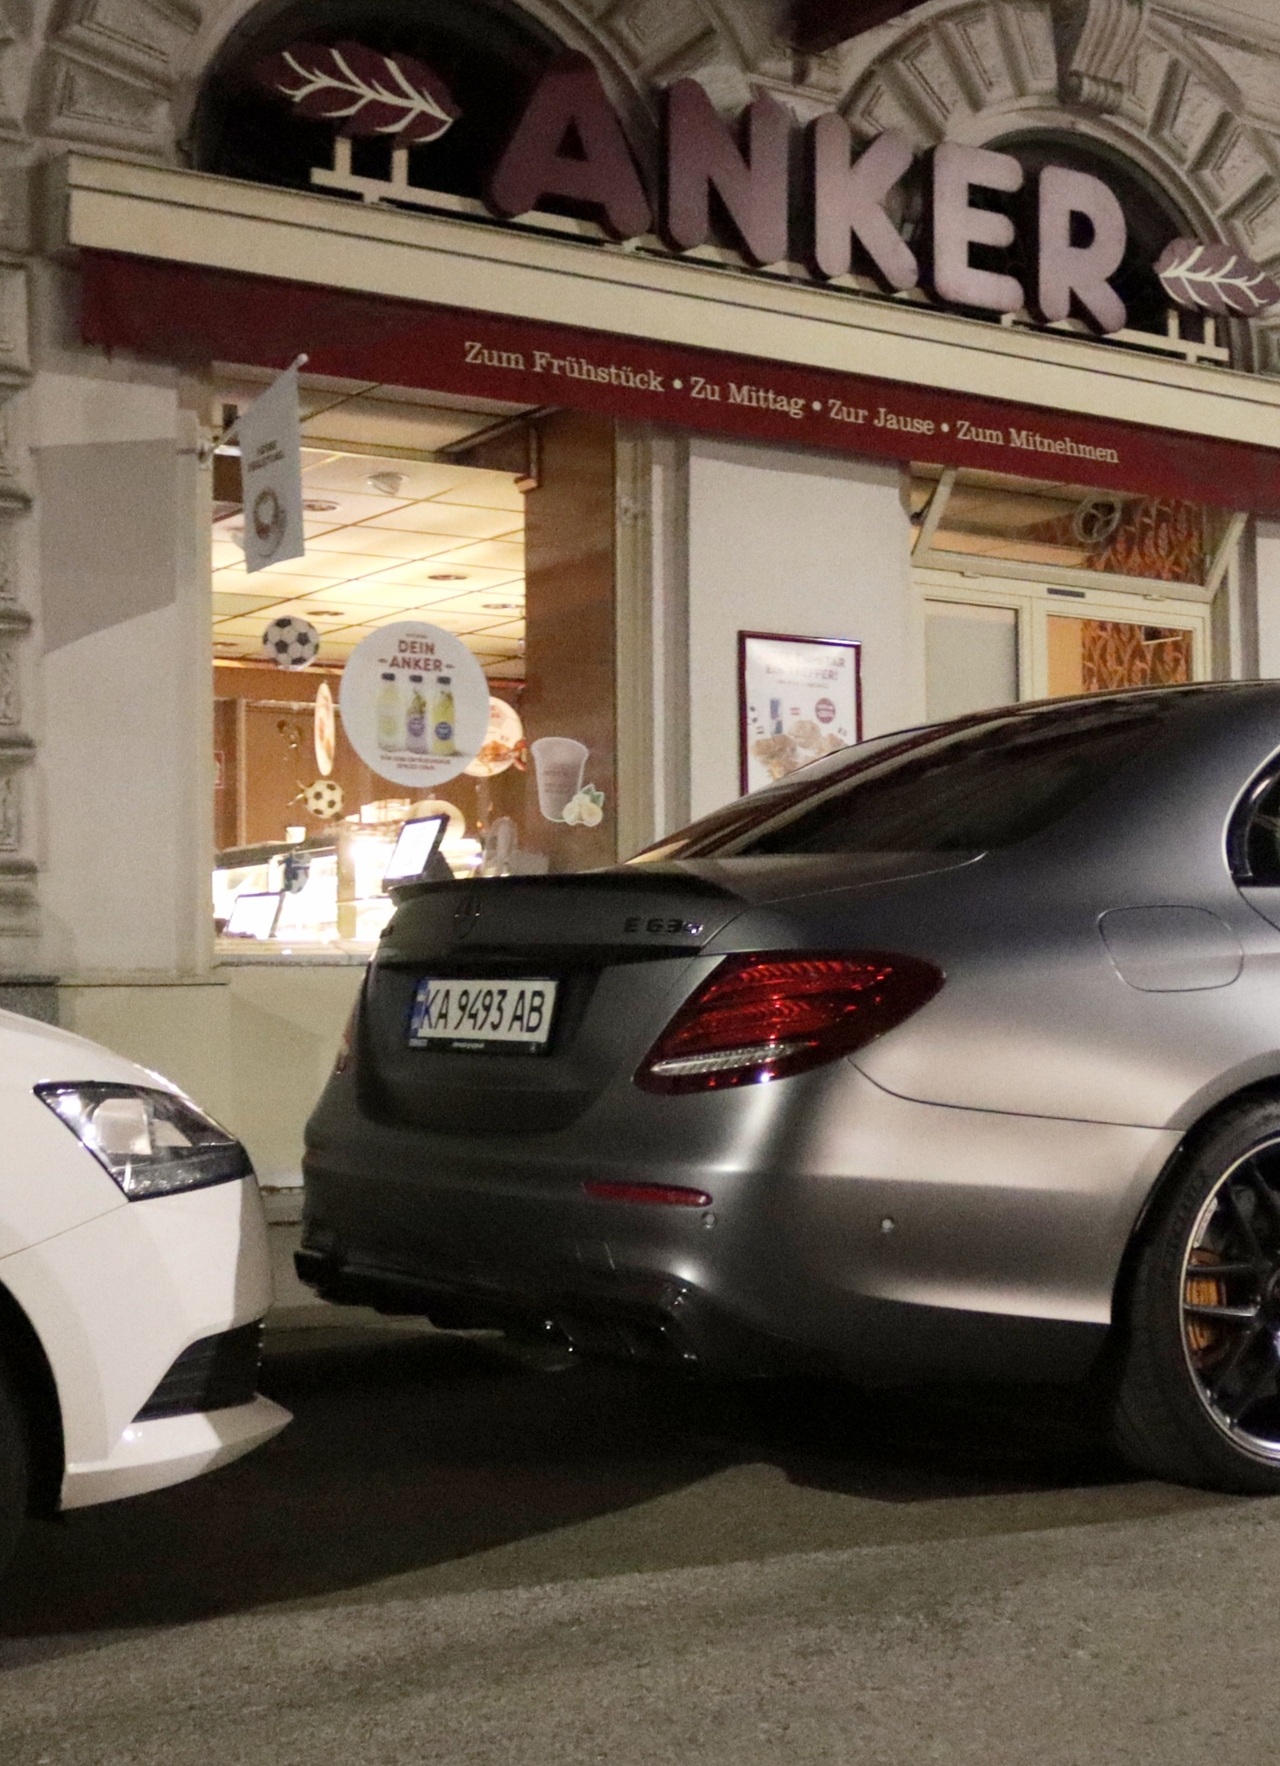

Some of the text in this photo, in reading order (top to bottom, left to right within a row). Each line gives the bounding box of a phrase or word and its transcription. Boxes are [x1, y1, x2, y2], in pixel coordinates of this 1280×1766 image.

[488, 48, 1128, 334] ANKER
[464, 341, 1120, 464] Zum Frühstück Zu Mittag Zur Jause Zum Mitnehmen
[389, 655, 443, 672] ANKER
[398, 639, 435, 656] DEIN
[420, 989, 546, 1033] KA 9493 AB
